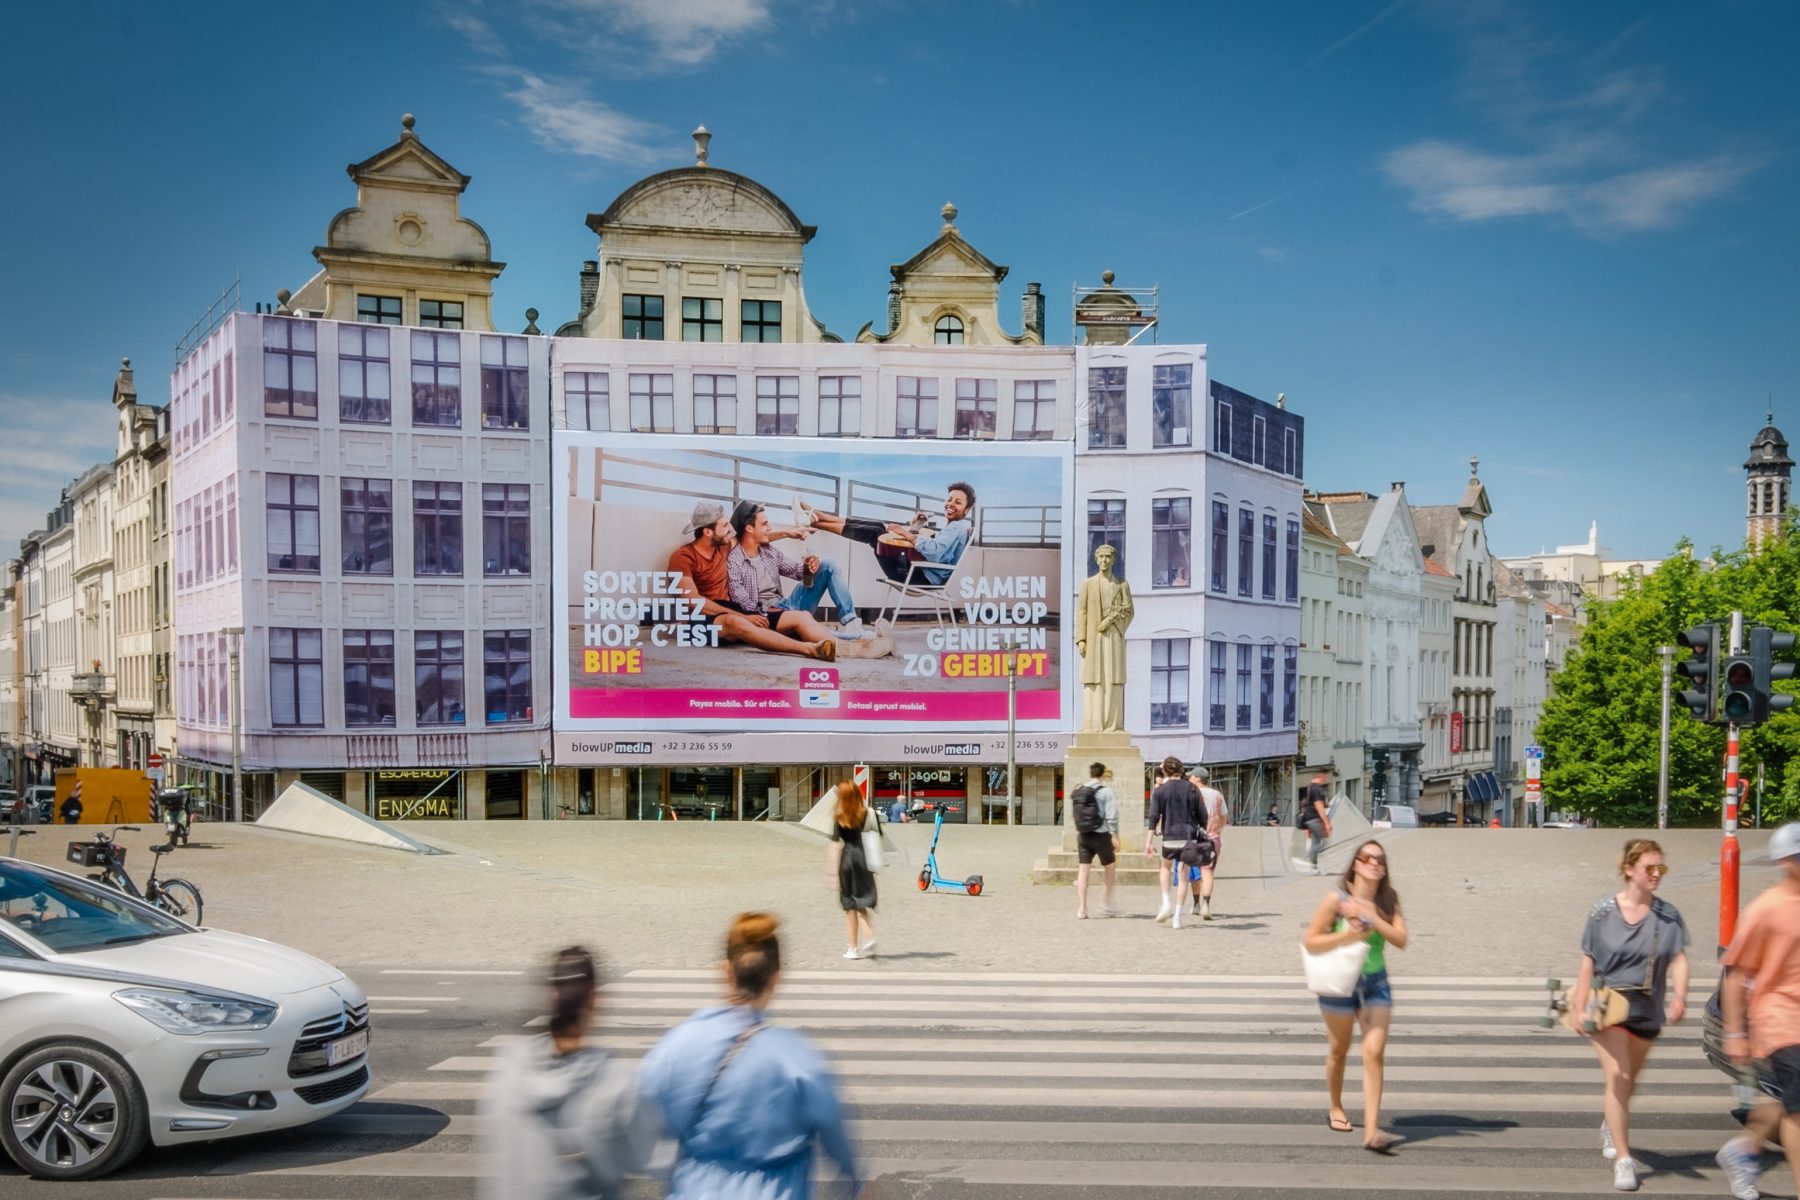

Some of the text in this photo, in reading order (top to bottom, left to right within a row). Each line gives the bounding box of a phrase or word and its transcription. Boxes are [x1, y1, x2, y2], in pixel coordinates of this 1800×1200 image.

[583, 570, 691, 595] SORTEZ,
[959, 575, 1046, 599] SAMEN
[584, 597, 706, 621] PROFITEZ
[964, 601, 1047, 625] VOLOP
[584, 623, 643, 647] HOP,
[926, 627, 1046, 651] GENIETEN
[584, 647, 641, 673] BIPÉ
[903, 653, 938, 677] ZO
[689, 699, 713, 709] Payez
[714, 700, 742, 708] mobile.
[759, 700, 767, 708] et
[768, 700, 792, 708] facile.
[847, 701, 927, 712] Betaal gerust mobiel.
[990, 740, 1005, 749] +32
[1016, 740, 1032, 749] 236
[1035, 741, 1045, 749] 55
[1047, 741, 1058, 749] 59
[379, 799, 449, 817] ENYGMA
